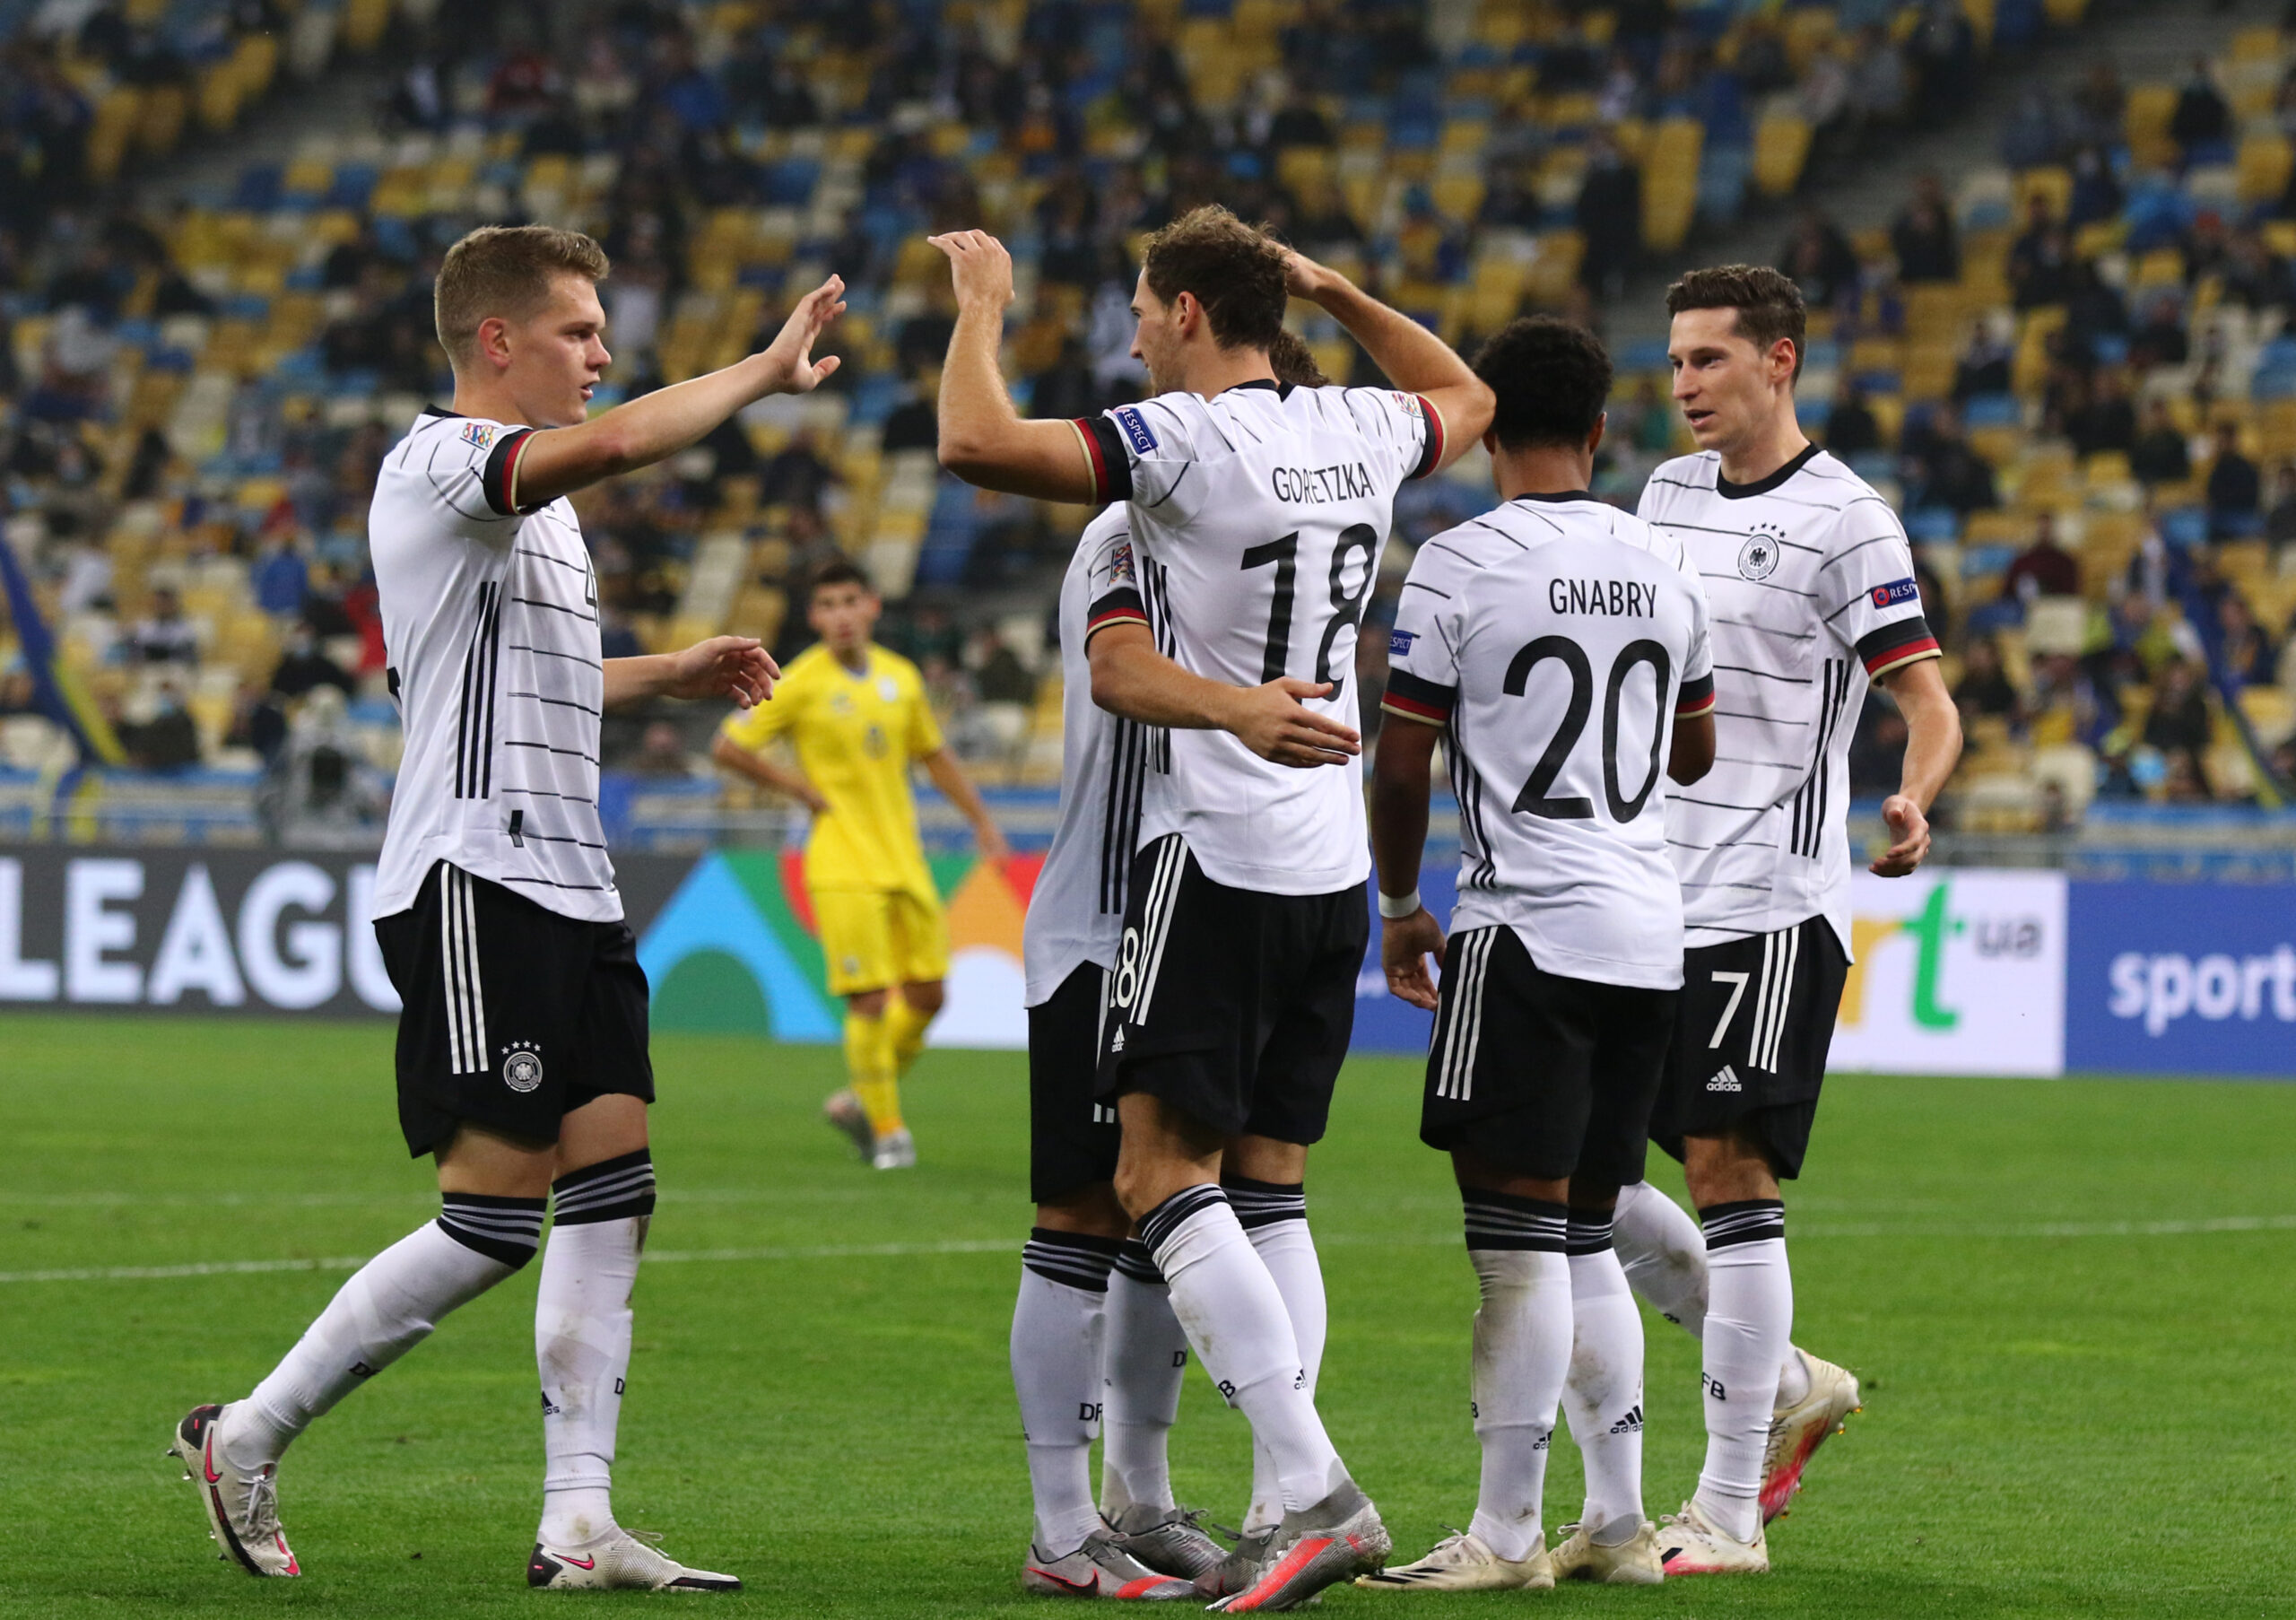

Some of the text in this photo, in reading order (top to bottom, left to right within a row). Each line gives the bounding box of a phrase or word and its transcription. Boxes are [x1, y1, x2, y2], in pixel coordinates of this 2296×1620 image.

[1272, 462, 1376, 504] GORETZKA
[1240, 523, 1378, 704] 18
[1549, 578, 1657, 619] GNABRY
[1502, 635, 1671, 824] 20
[1976, 917, 2042, 959] ua
[1708, 971, 1750, 1050] 7
[2108, 942, 2296, 1038] sport
[1706, 1082, 1742, 1093] adidas
